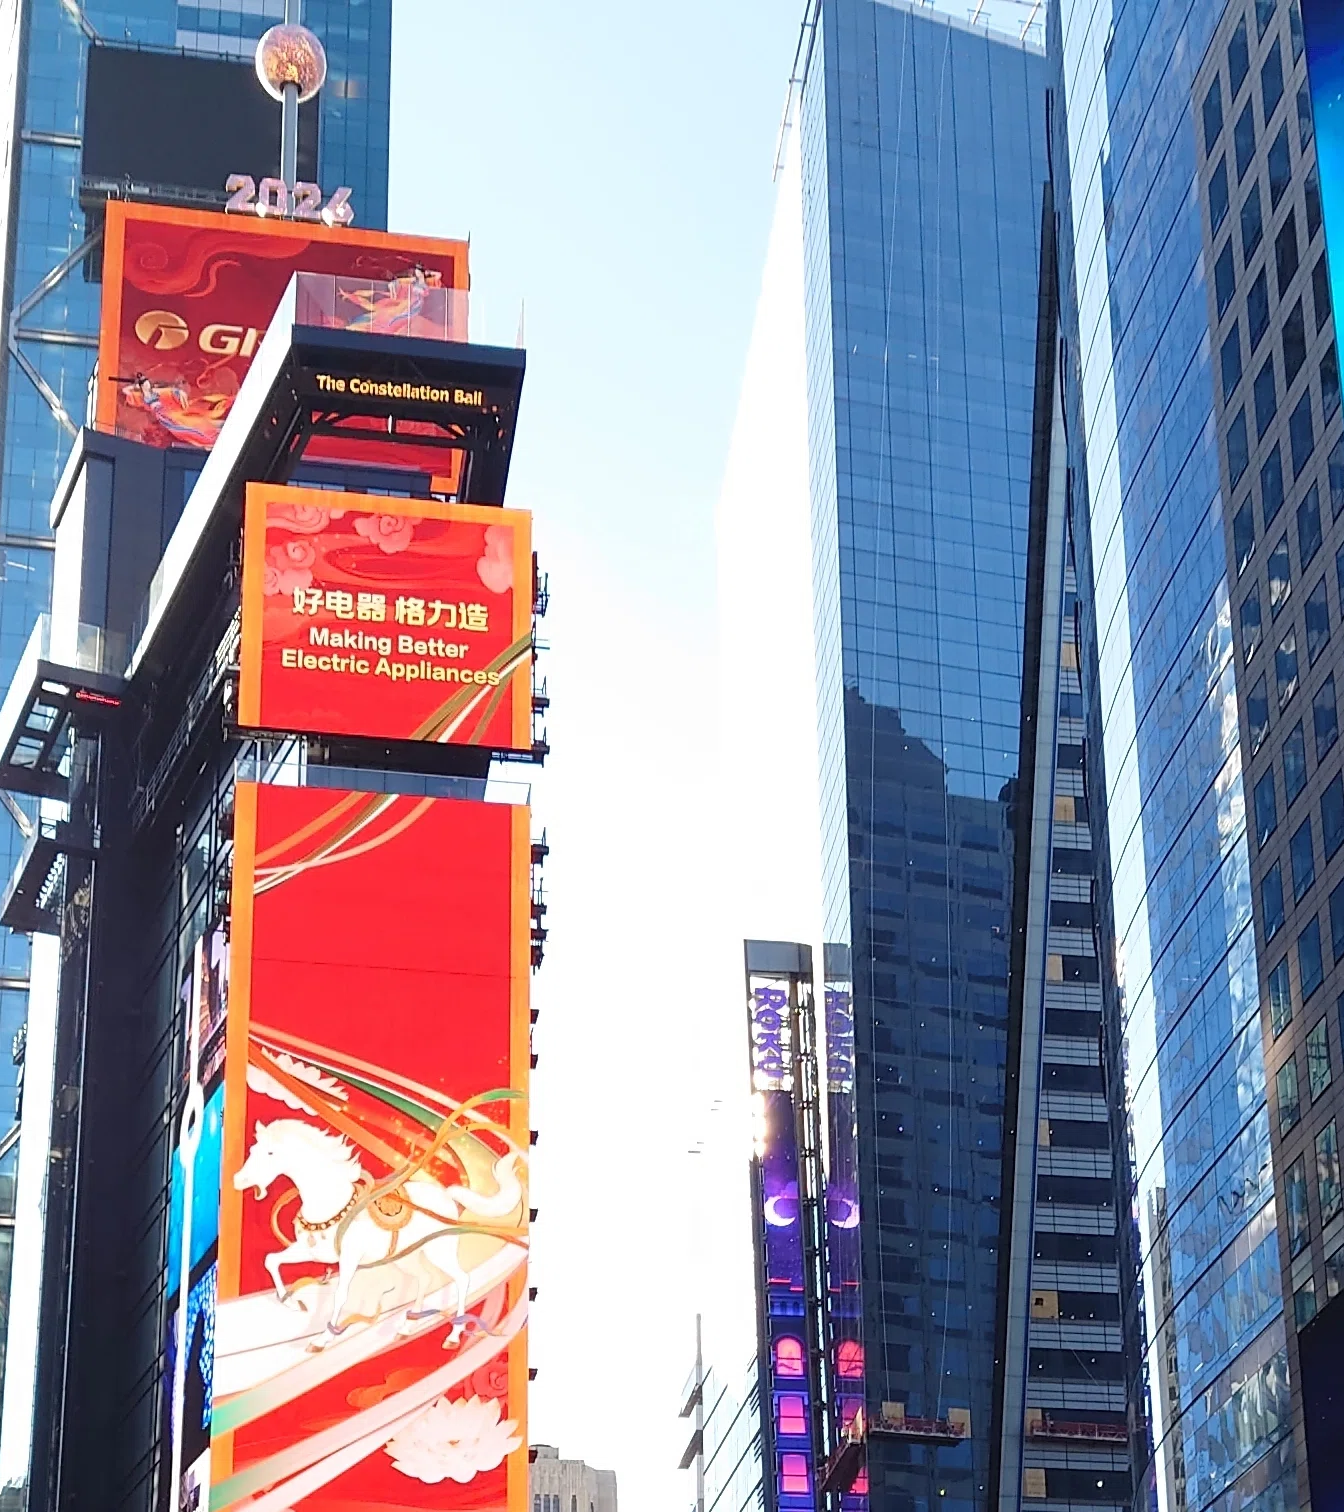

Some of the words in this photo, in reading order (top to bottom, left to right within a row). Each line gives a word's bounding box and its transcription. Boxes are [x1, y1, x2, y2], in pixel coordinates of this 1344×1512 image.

[225, 173, 355, 228] 2026
[316, 373, 346, 392] The
[349, 377, 451, 404] Constellation
[454, 388, 483, 407] Ball
[291, 586, 388, 623] 好电器
[394, 595, 490, 633] 格力造
[309, 627, 393, 656] Making
[398, 634, 470, 659] Better
[281, 648, 371, 675] Electric
[374, 657, 501, 686] Appliances
